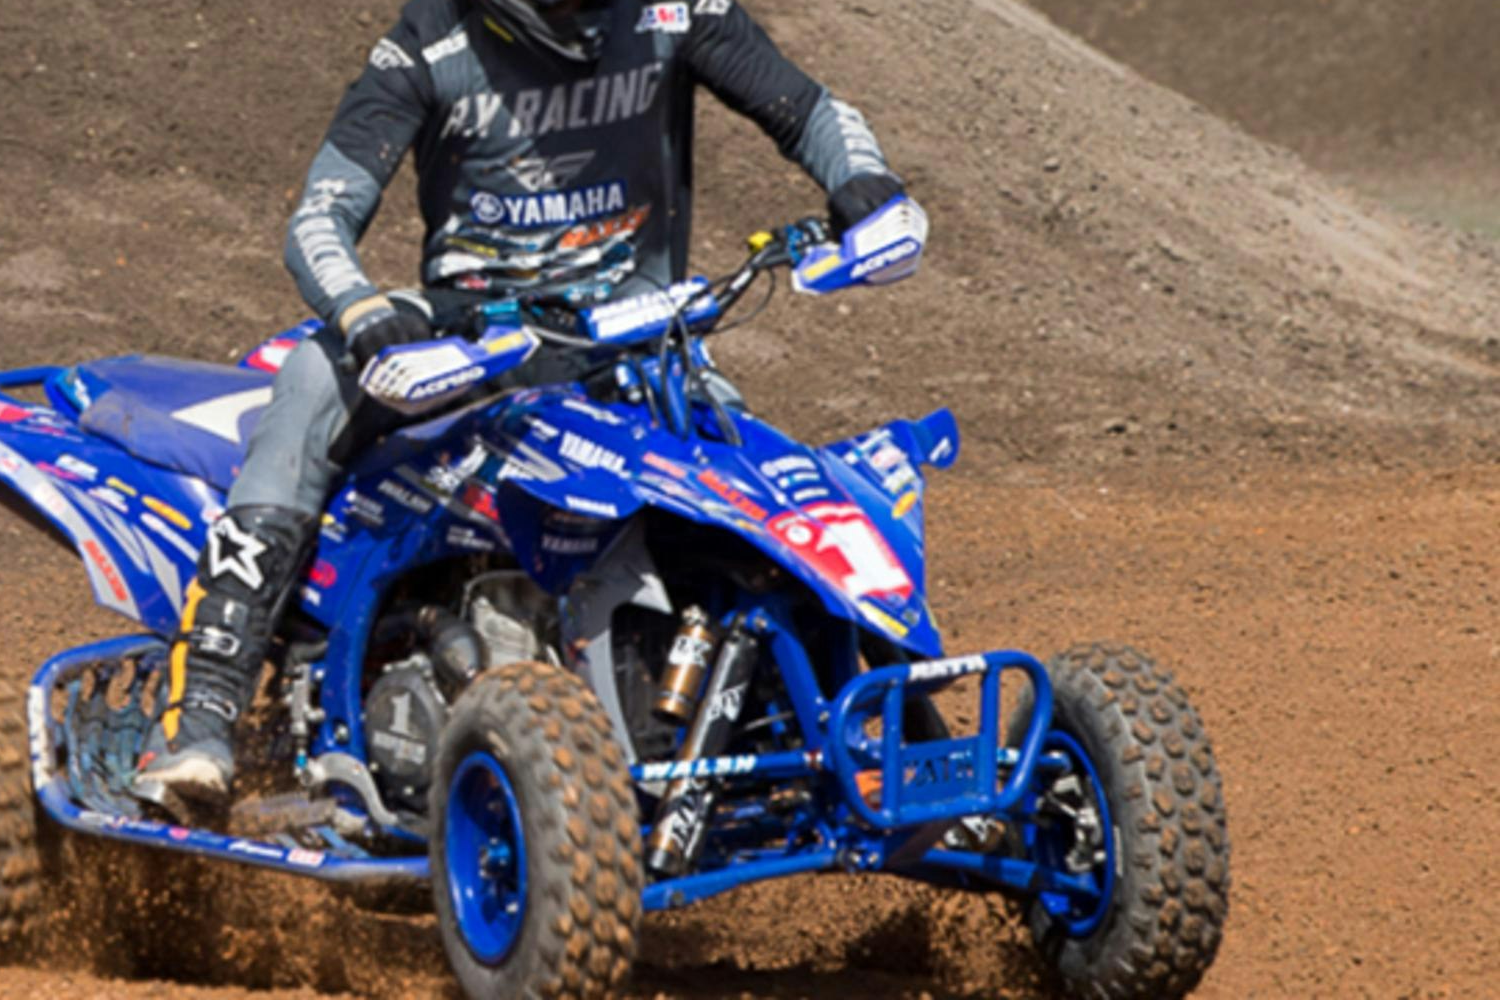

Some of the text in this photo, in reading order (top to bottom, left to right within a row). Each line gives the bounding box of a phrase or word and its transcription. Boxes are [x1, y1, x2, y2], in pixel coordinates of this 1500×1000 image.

[507, 62, 664, 137] RACING
[504, 183, 625, 224] YAMAHA
[816, 518, 913, 600] 1
[642, 754, 757, 780] WALSH
